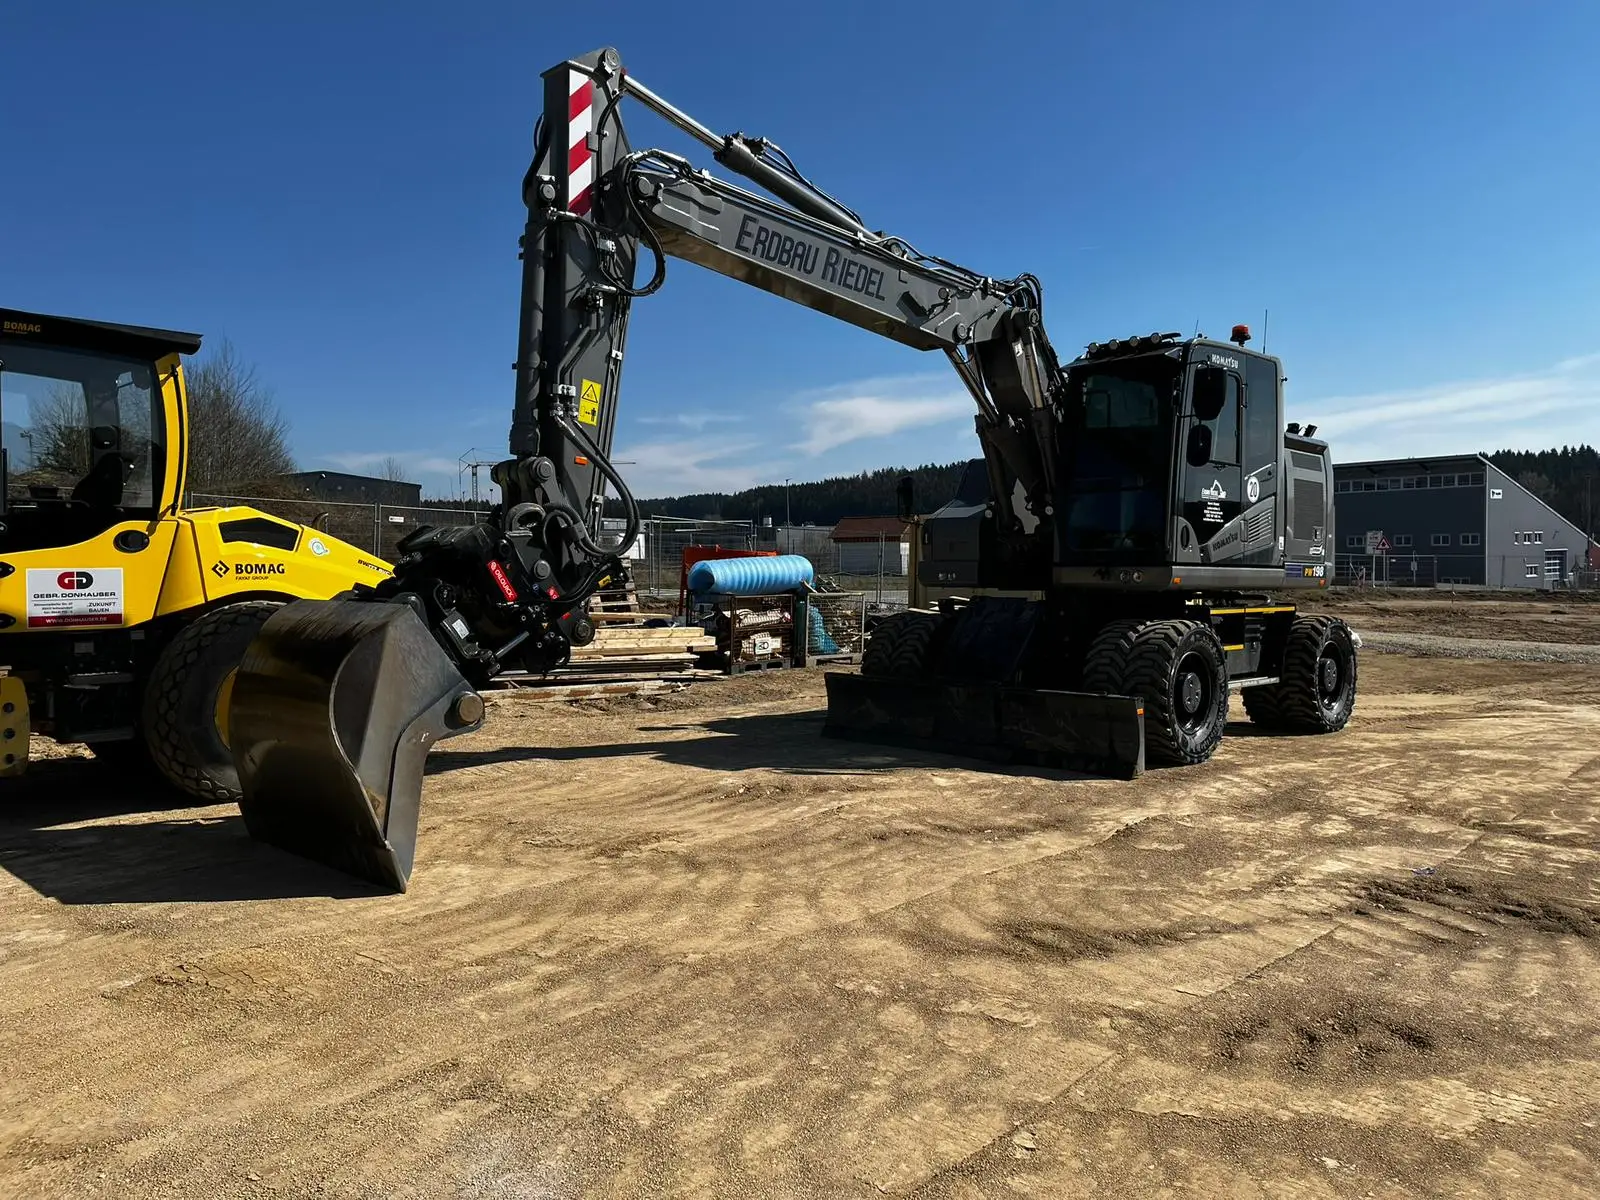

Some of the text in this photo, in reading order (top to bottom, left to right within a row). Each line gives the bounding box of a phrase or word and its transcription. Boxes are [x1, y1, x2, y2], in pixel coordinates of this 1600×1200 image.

[735, 213, 886, 301] ERDBAU RIEDEL
[3, 320, 41, 333] BOMAG
[1211, 353, 1239, 369] KOMATSU
[235, 563, 285, 575] BOMAG
[494, 569, 515, 599] OILQUICK
[61, 591, 116, 599] DONHAUSER
